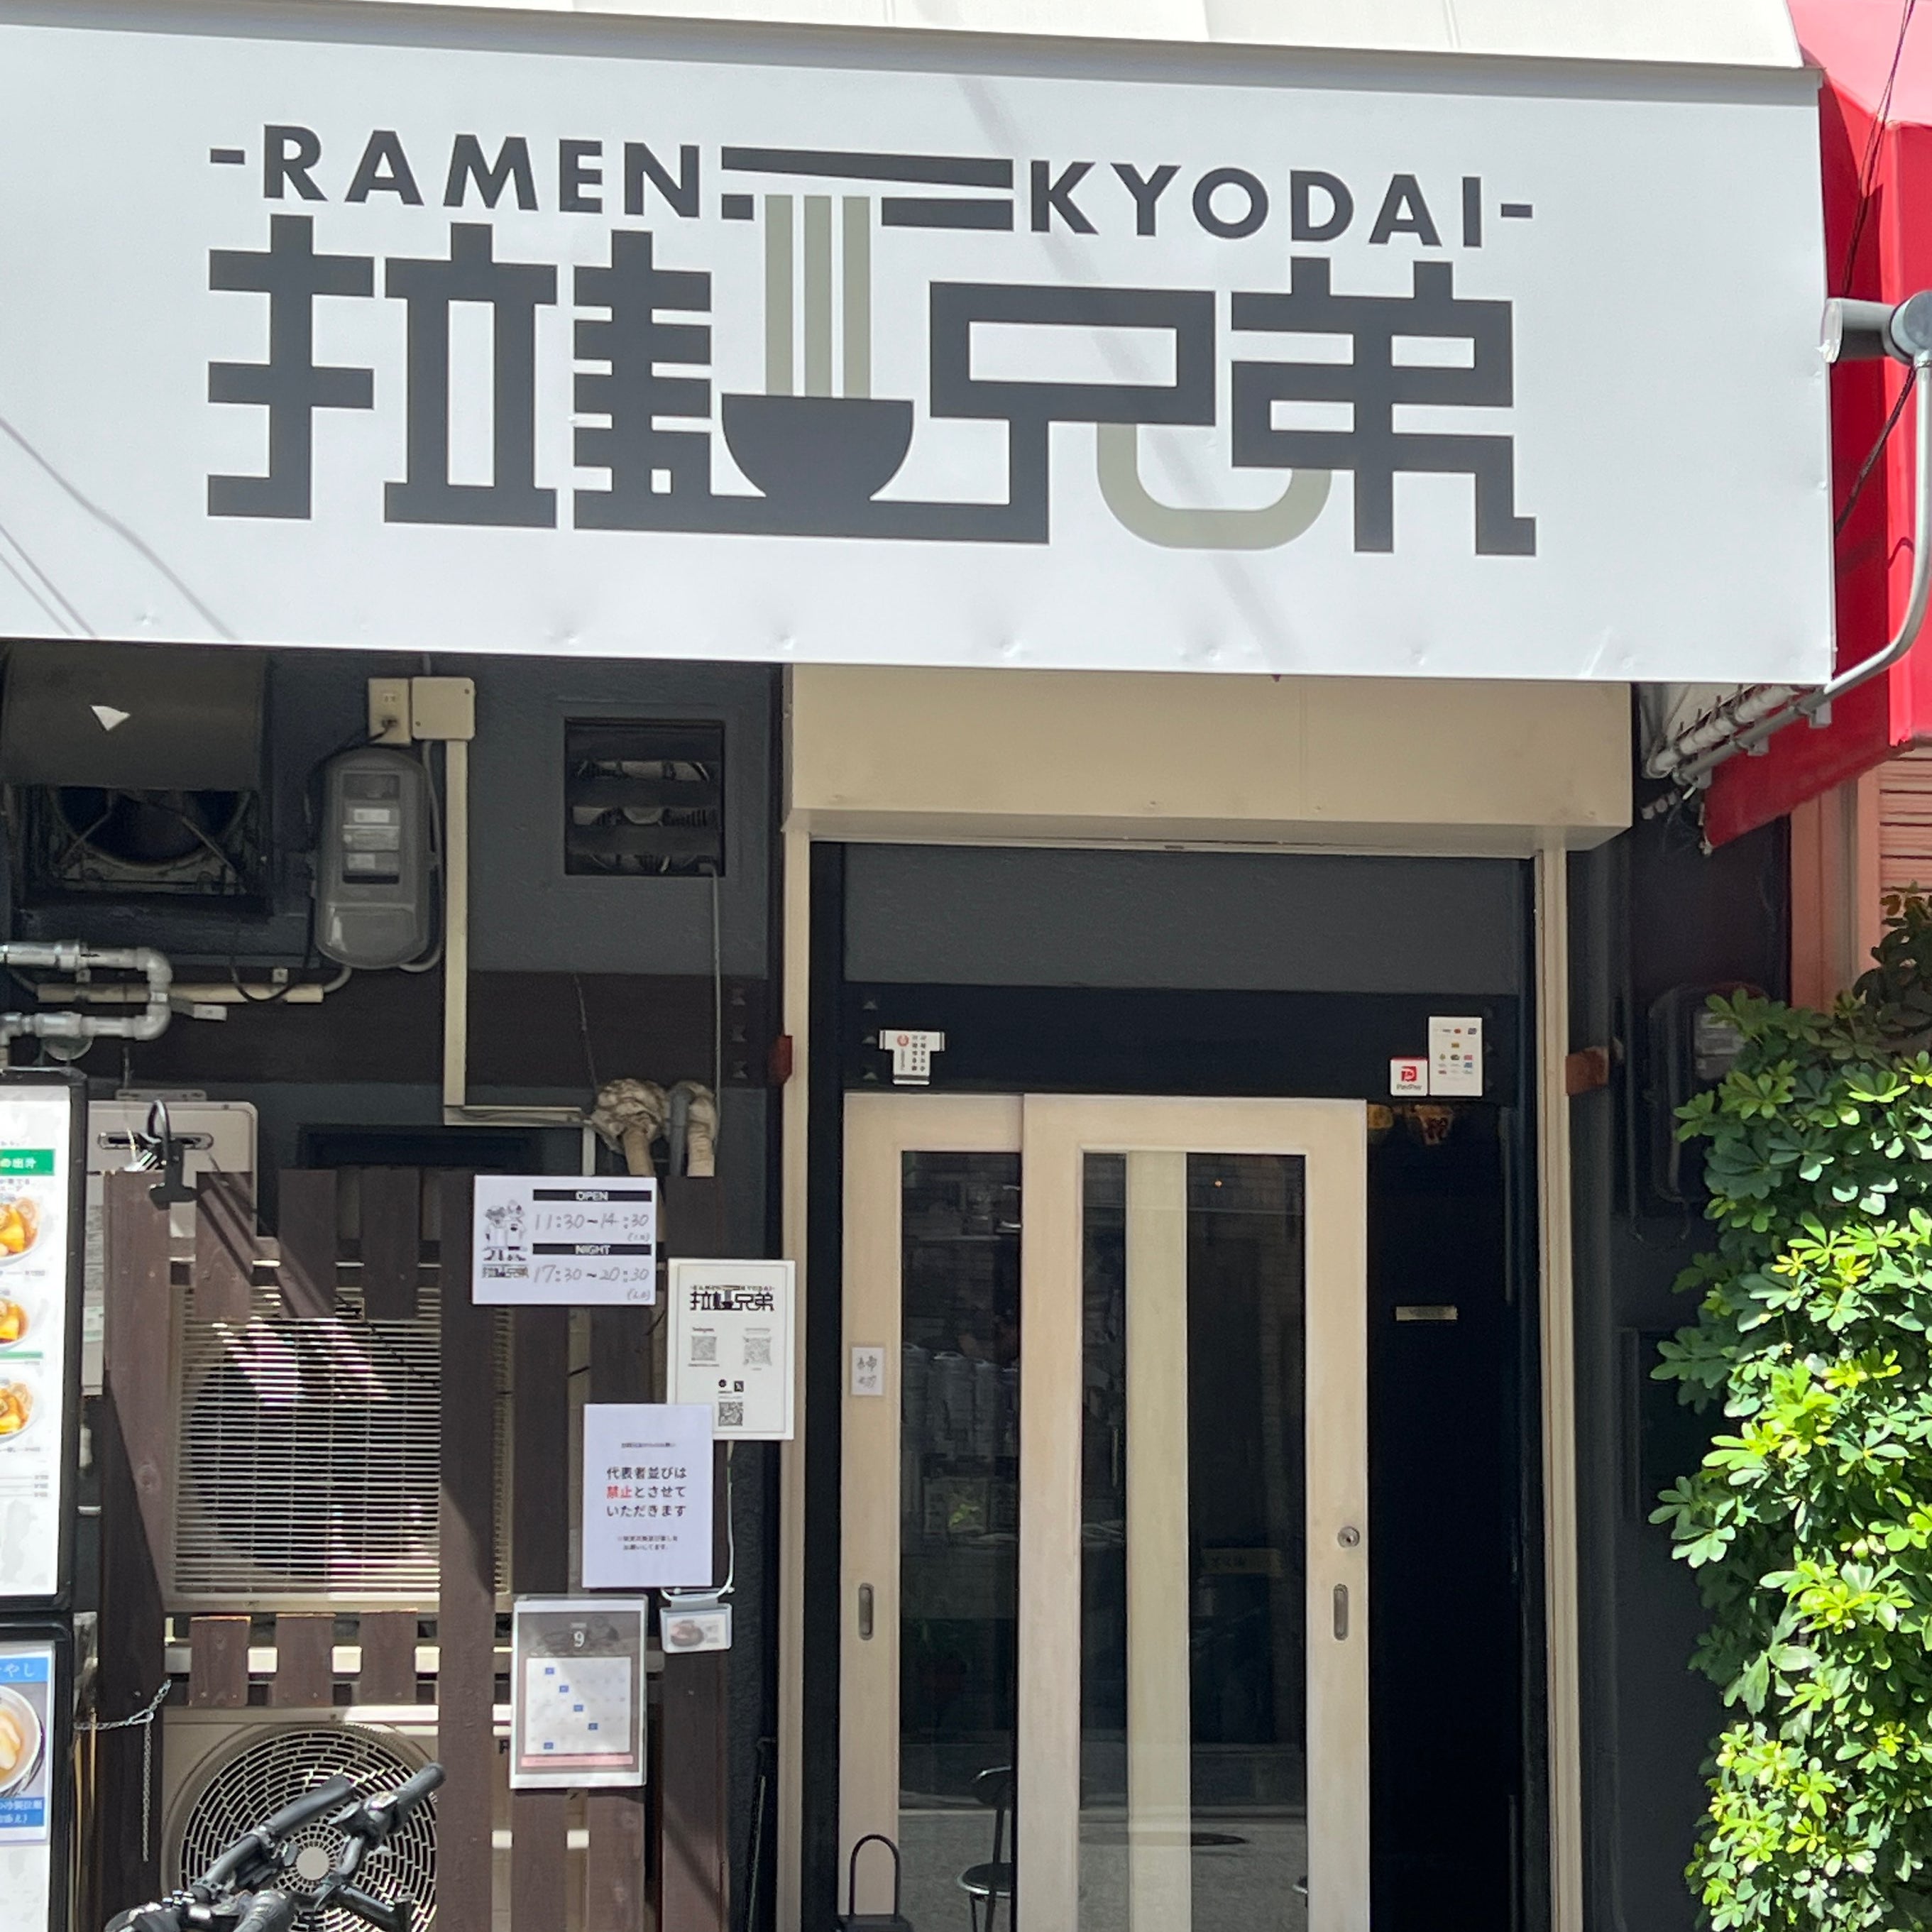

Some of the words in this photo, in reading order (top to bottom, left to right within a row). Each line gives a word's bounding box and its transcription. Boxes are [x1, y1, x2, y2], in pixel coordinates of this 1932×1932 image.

[576, 1191, 608, 1201] OPEN
[575, 1244, 610, 1255] NIGHT
[606, 1466, 687, 1480] 代表者並びは
[606, 1486, 686, 1499] 禁止とさせて
[606, 1505, 686, 1517] いただきます
[573, 1630, 585, 1647] 9
[0, 1663, 35, 1677] やし
